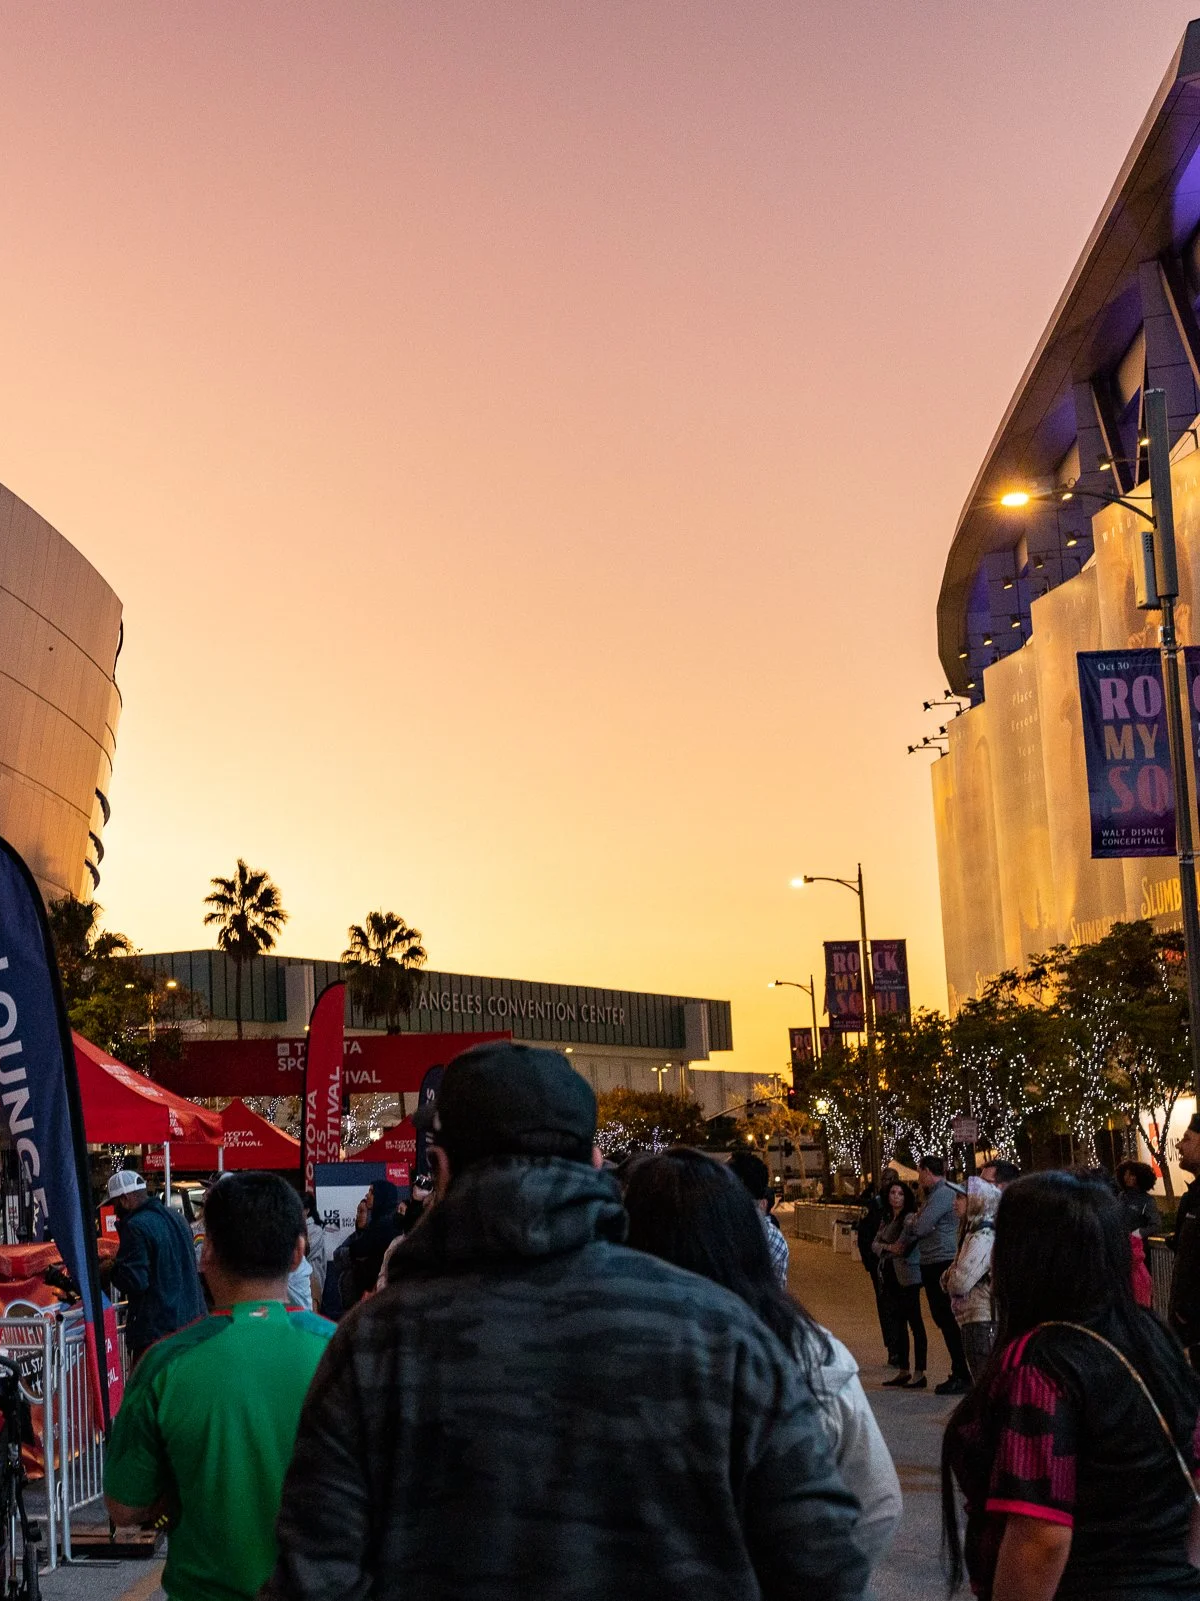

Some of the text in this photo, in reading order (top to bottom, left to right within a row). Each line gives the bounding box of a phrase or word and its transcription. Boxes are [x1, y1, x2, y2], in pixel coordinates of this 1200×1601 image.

[1098, 662, 1130, 671] Oct 30
[1103, 723, 1159, 760] MY
[1102, 827, 1165, 838] WALT DISNEY
[1102, 836, 1166, 846] CONCERT HALL
[1140, 876, 1182, 919] SLUMB
[834, 973, 858, 991] MY
[419, 990, 626, 1026] ANGELES CONVENTION CENTER
[305, 1089, 318, 1193] TOYOTA
[324, 1209, 340, 1218] US
